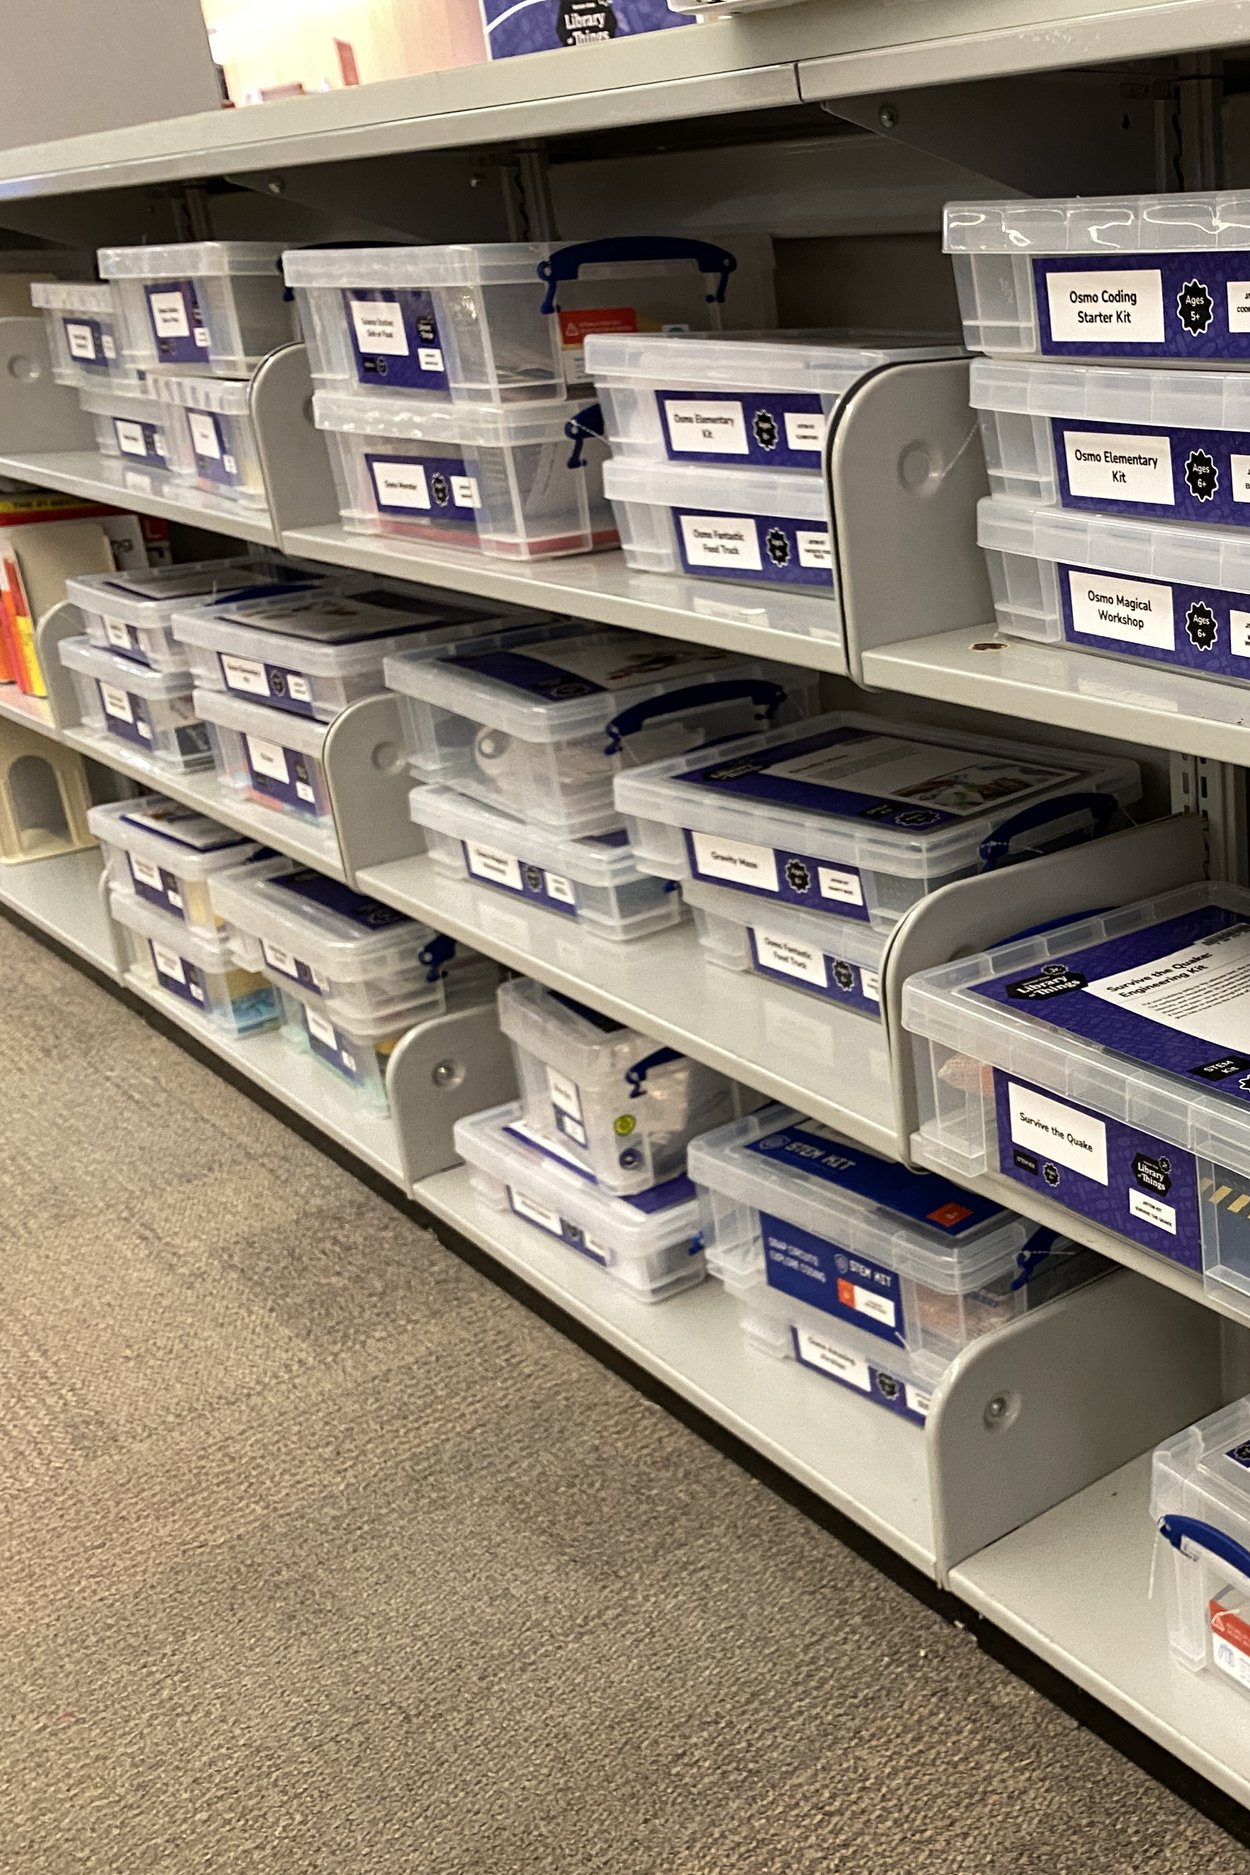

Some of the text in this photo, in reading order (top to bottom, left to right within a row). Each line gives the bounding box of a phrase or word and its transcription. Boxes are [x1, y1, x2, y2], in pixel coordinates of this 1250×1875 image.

[564, 12, 606, 30] Library
[1069, 290, 1137, 306] Osmo Coding
[1185, 294, 1204, 306] Ages
[1078, 310, 1131, 324] Starter Kit
[1190, 311, 1201, 321] 5+
[674, 414, 734, 426] Osmo Elementary
[1074, 449, 1158, 470] Osmo Elementary
[1112, 471, 1127, 484] Kit
[1192, 464, 1210, 475] Ages
[1198, 479, 1207, 488] 6+
[694, 529, 745, 542] Osmo Fantastic
[704, 544, 739, 555] Food Truck
[1088, 590, 1152, 612] Osmo Magical
[1098, 610, 1144, 630] Workshop
[1192, 614, 1210, 626] Ages
[1197, 629, 1206, 638] 6+
[711, 851, 758, 869] Gravity Maze
[773, 951, 807, 969] Food Truck
[784, 944, 812, 960] Fantastic
[1016, 975, 1067, 995] Library
[1033, 980, 1081, 997] Things
[1106, 974, 1150, 993] Survive
[1151, 968, 1173, 979] the
[1118, 964, 1209, 998] Engineering Kit
[1204, 1060, 1234, 1072] STEM
[1020, 1112, 1093, 1153] Survive the Quake
[785, 1142, 856, 1170] STEM KIT
[1138, 1163, 1164, 1182] Library
[1142, 1174, 1166, 1192] Things
[850, 1260, 892, 1287] STEM KIT
